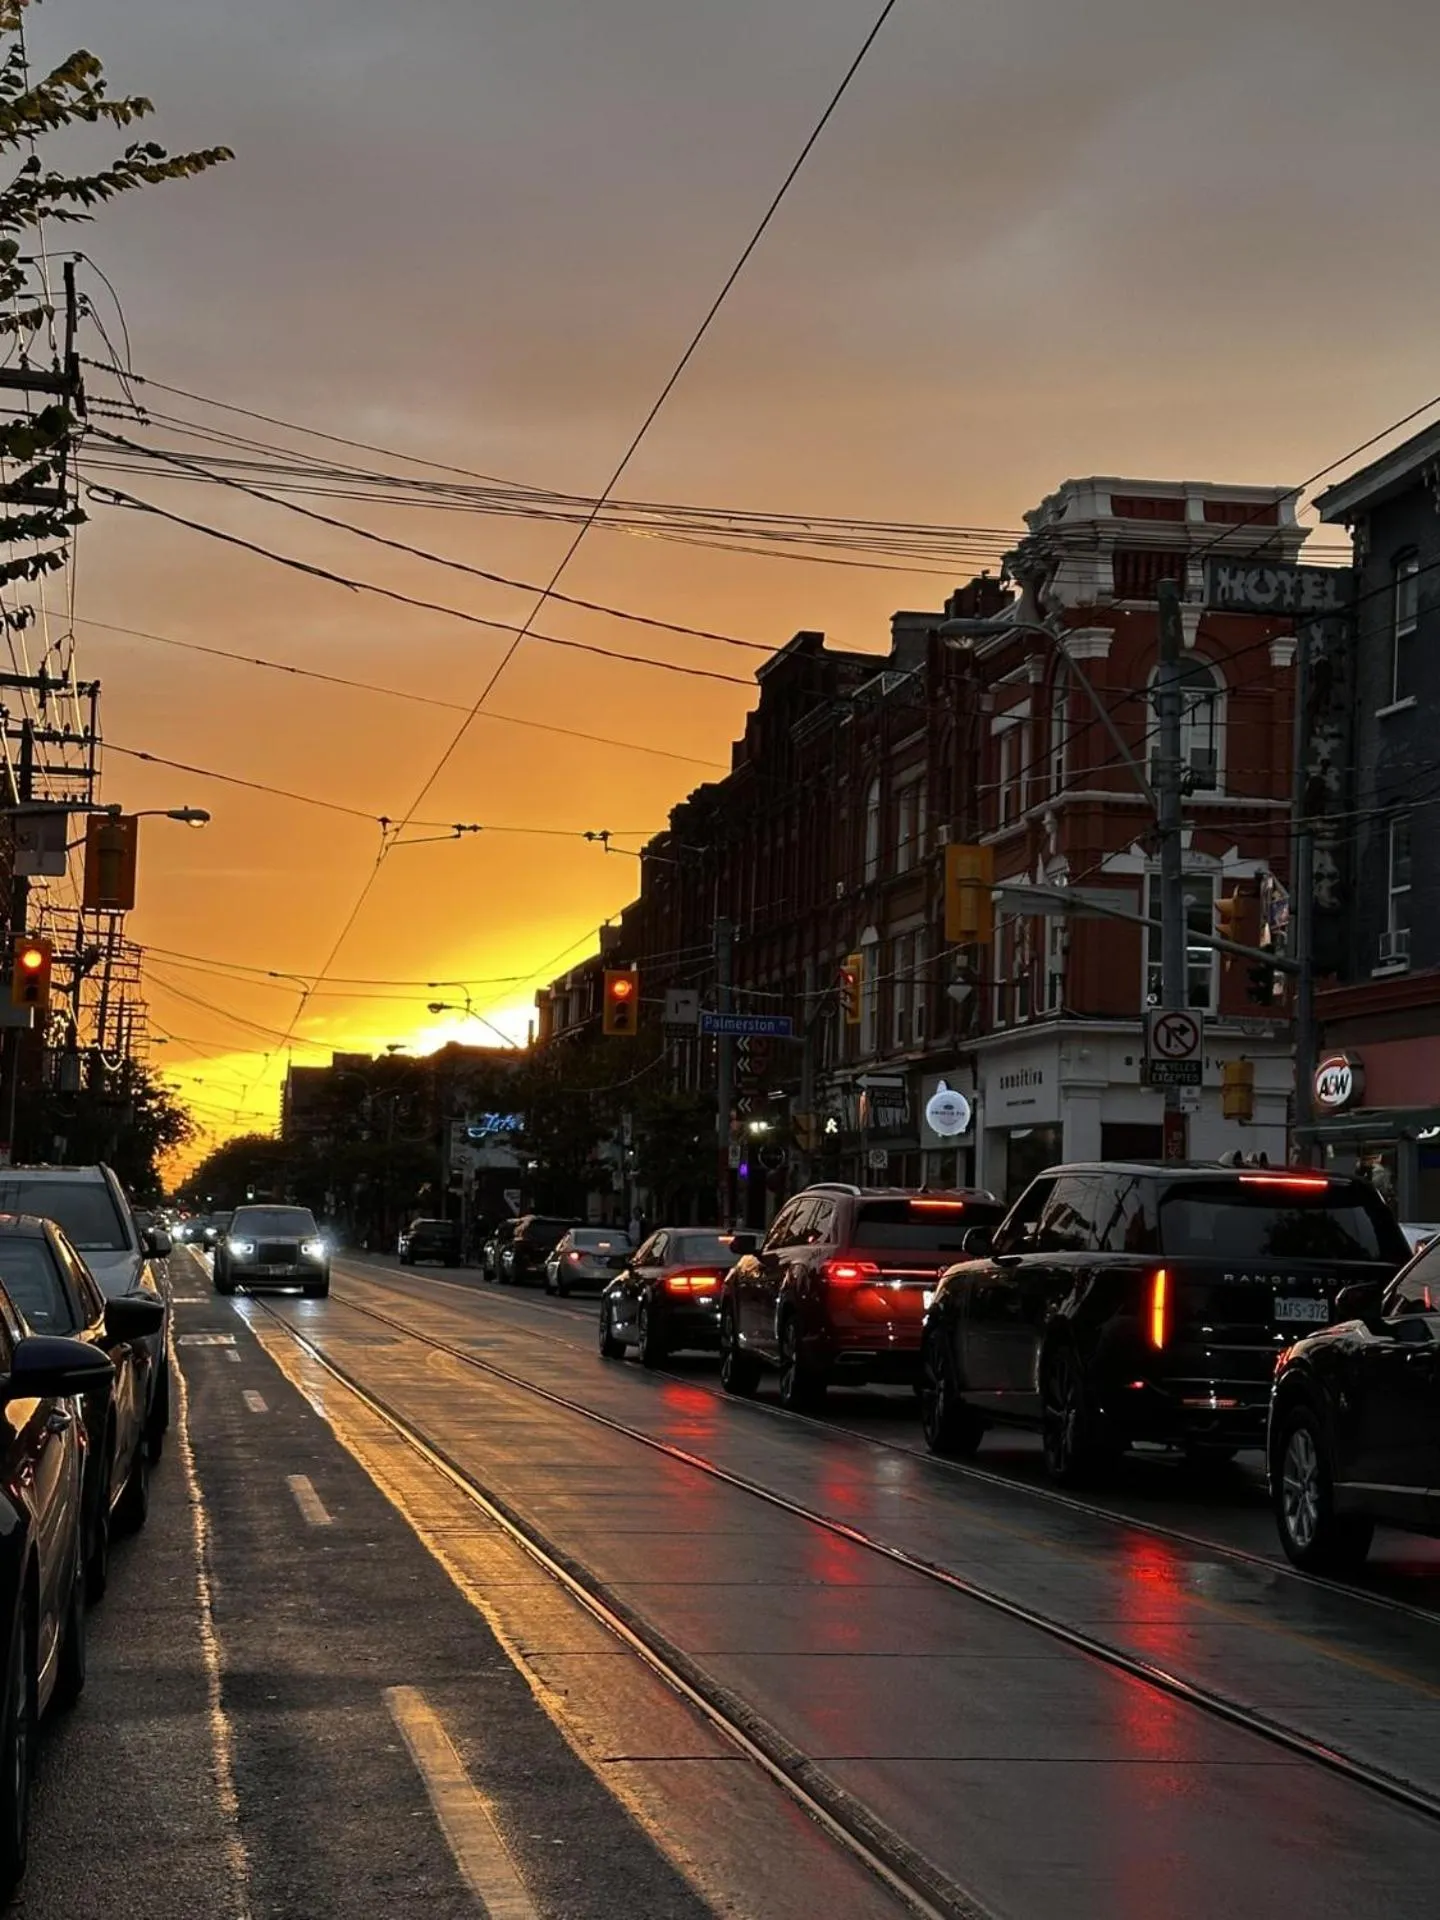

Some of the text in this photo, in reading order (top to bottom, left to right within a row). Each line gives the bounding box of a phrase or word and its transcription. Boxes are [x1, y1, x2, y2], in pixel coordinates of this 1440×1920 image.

[1217, 567, 1346, 610] HOTEL
[704, 1016, 775, 1032] Palmerston
[1320, 1073, 1350, 1097] A&W
[1223, 1273, 1297, 1285] RANGE
